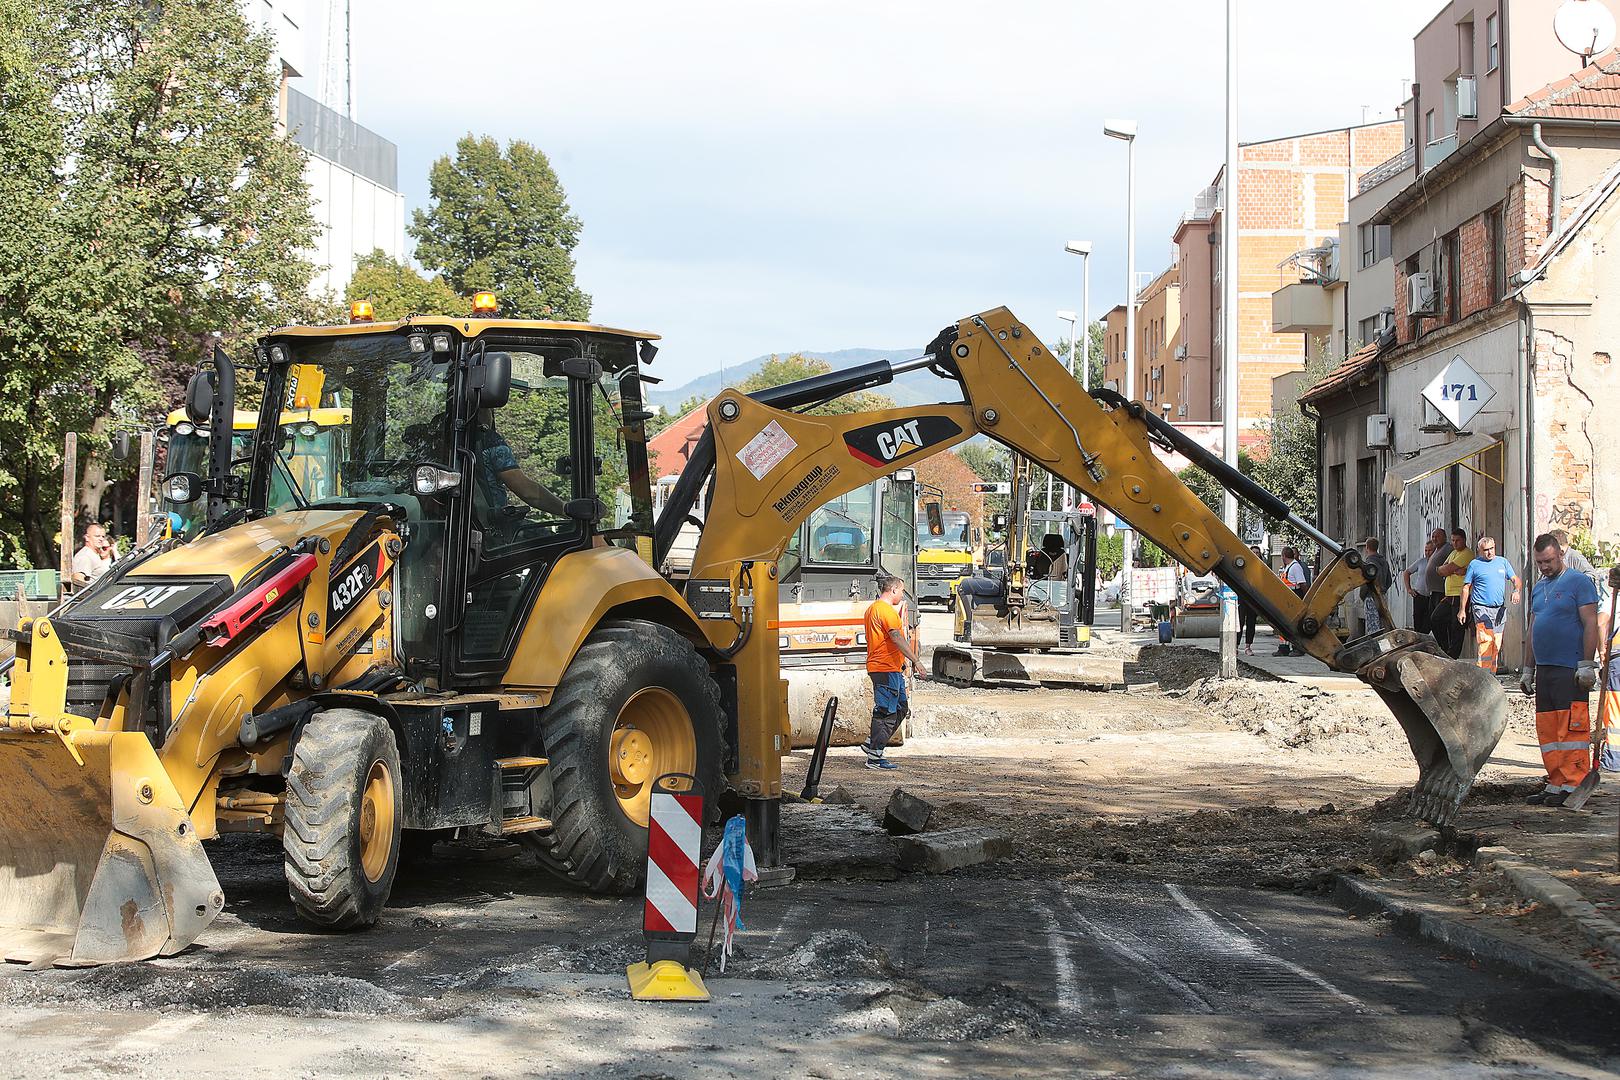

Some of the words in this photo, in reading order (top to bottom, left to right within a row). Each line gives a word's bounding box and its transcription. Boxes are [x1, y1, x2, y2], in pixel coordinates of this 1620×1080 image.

[1441, 384, 1478, 401] 171
[877, 420, 923, 459] CAT
[772, 465, 823, 513] Teknoxgroup
[100, 586, 190, 610] CAT
[332, 564, 372, 612] 432F2
